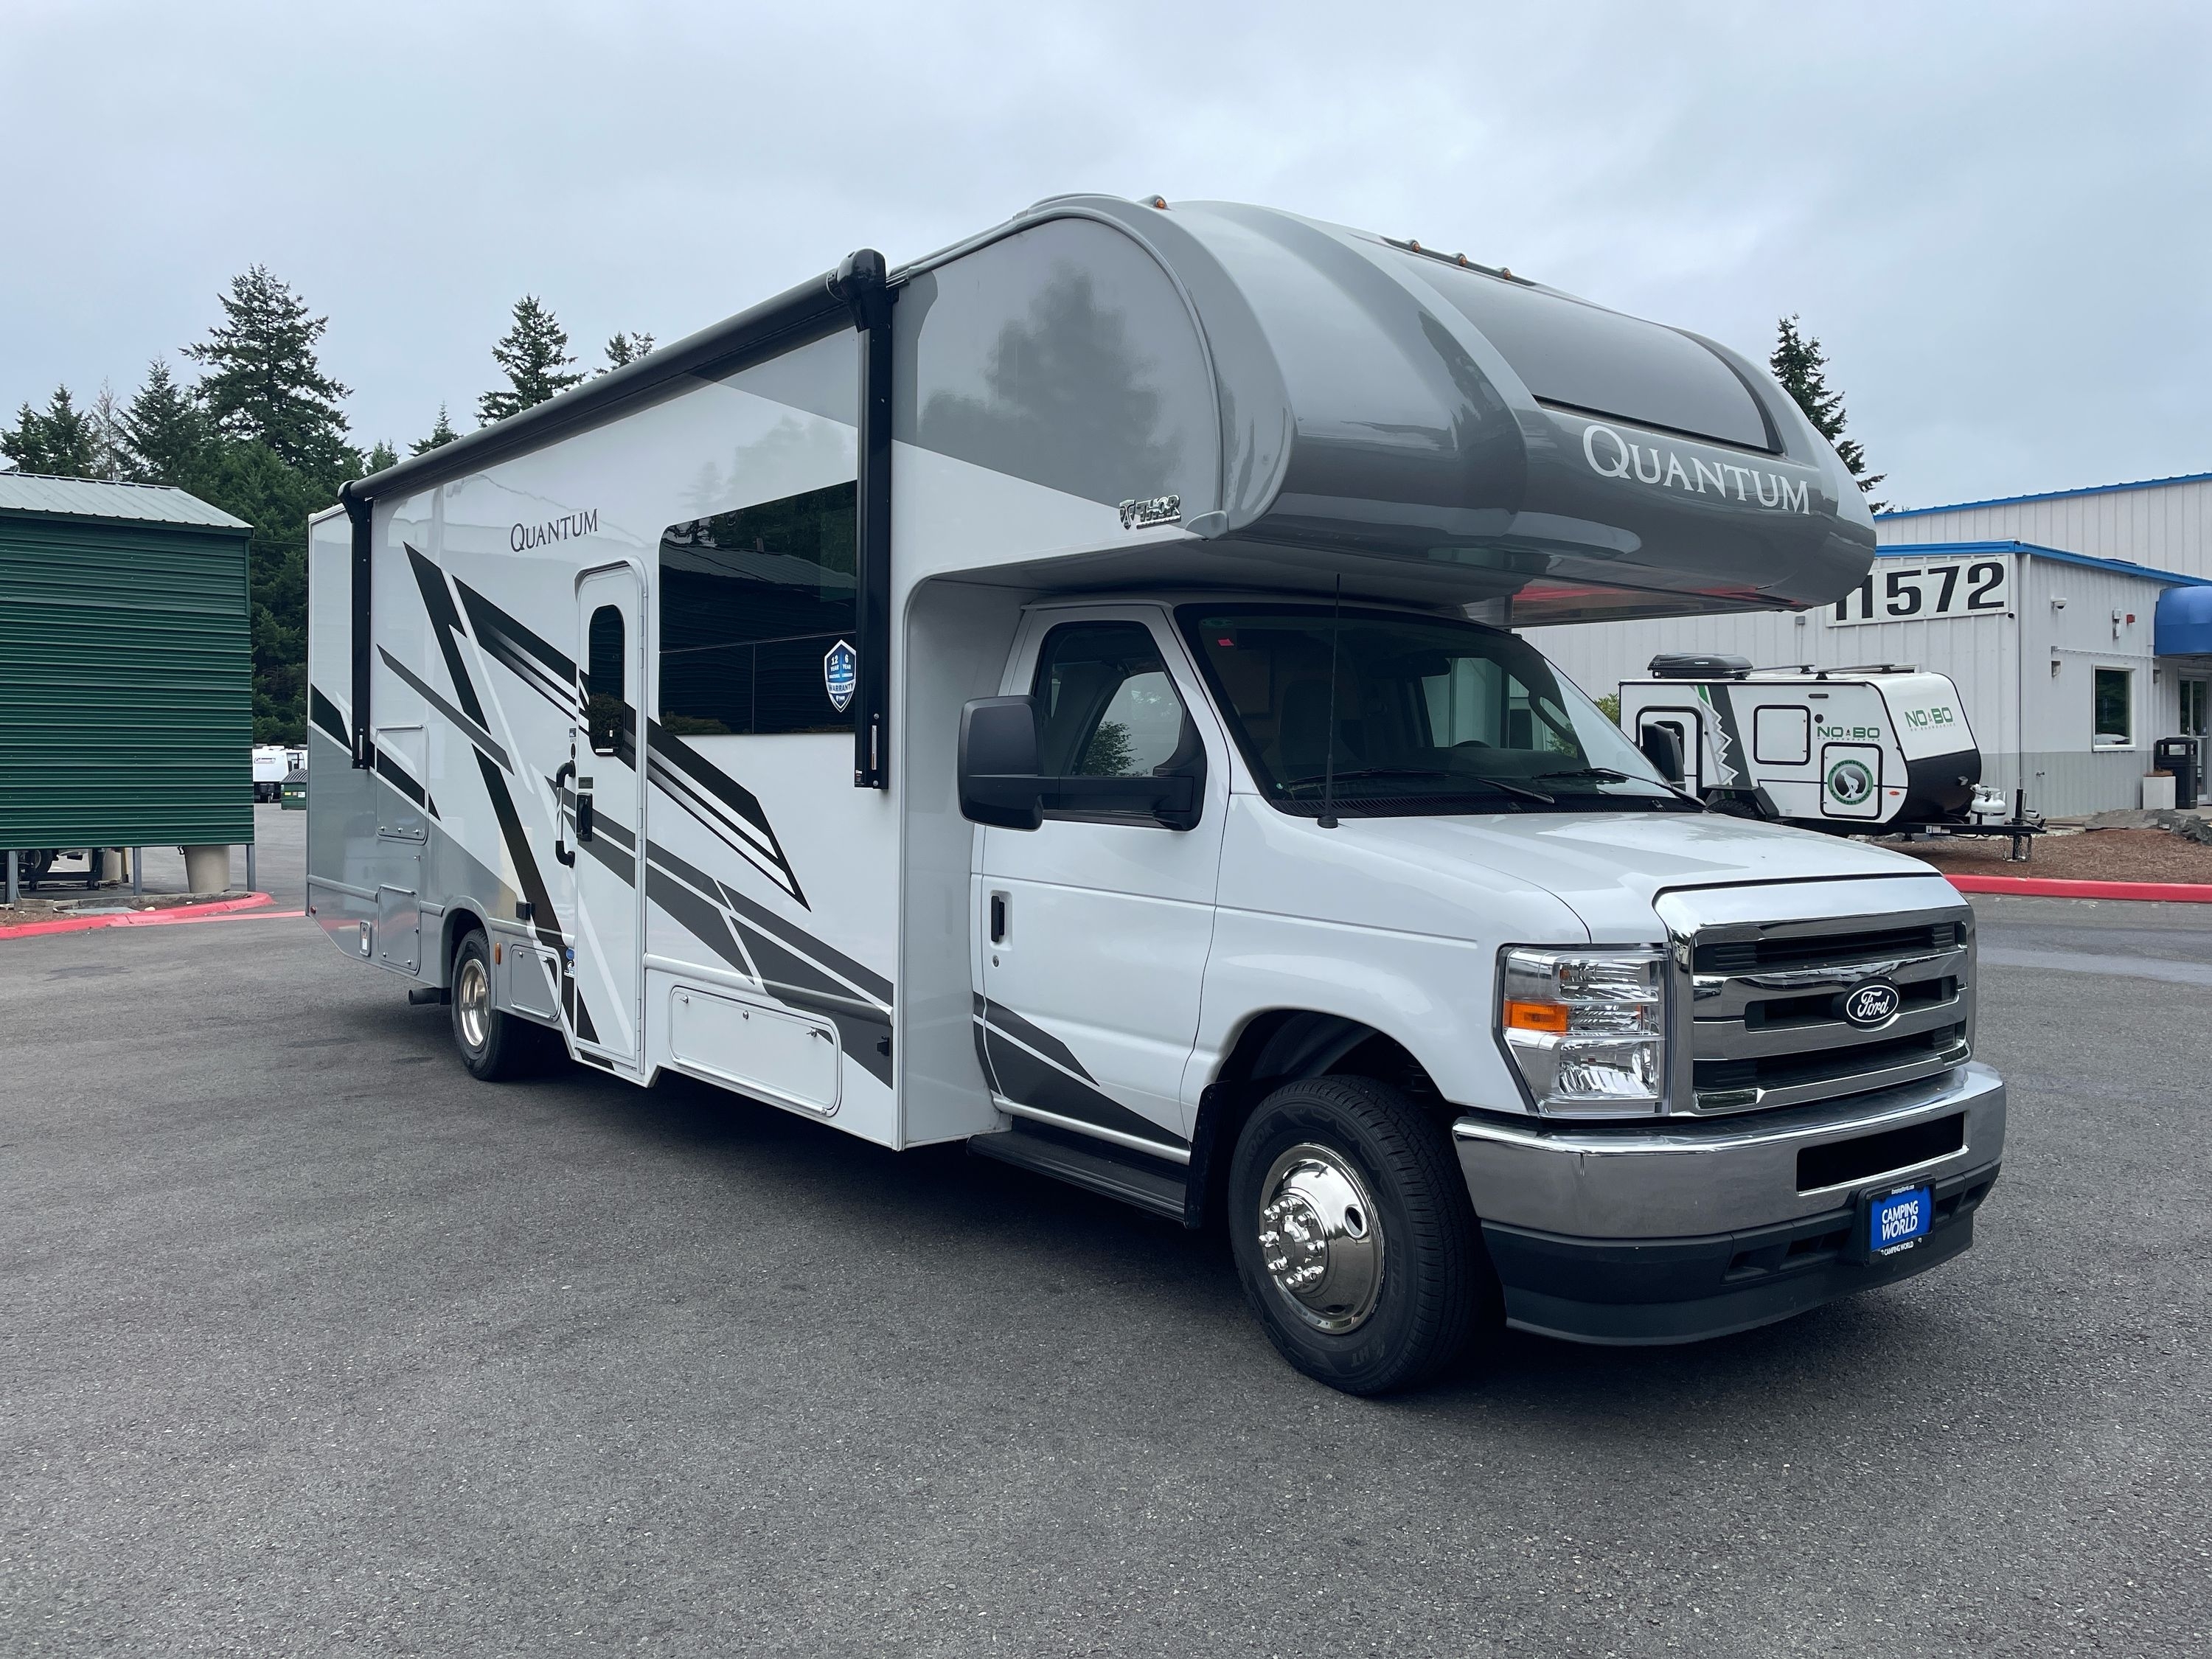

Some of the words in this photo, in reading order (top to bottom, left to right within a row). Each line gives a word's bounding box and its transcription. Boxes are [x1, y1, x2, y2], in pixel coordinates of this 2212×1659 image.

[1582, 425, 1810, 515] QUANTUM
[510, 509, 598, 552] QUANTUM
[831, 655, 838, 665] 12
[829, 683, 853, 692] WARRANTY
[1857, 990, 1891, 1018] Ford
[1882, 1200, 1919, 1224] CAMPING
[1882, 1215, 1918, 1241] WORLD
[1884, 1244, 1900, 1256] CAMPING
[1900, 1241, 1914, 1251] WORLD
